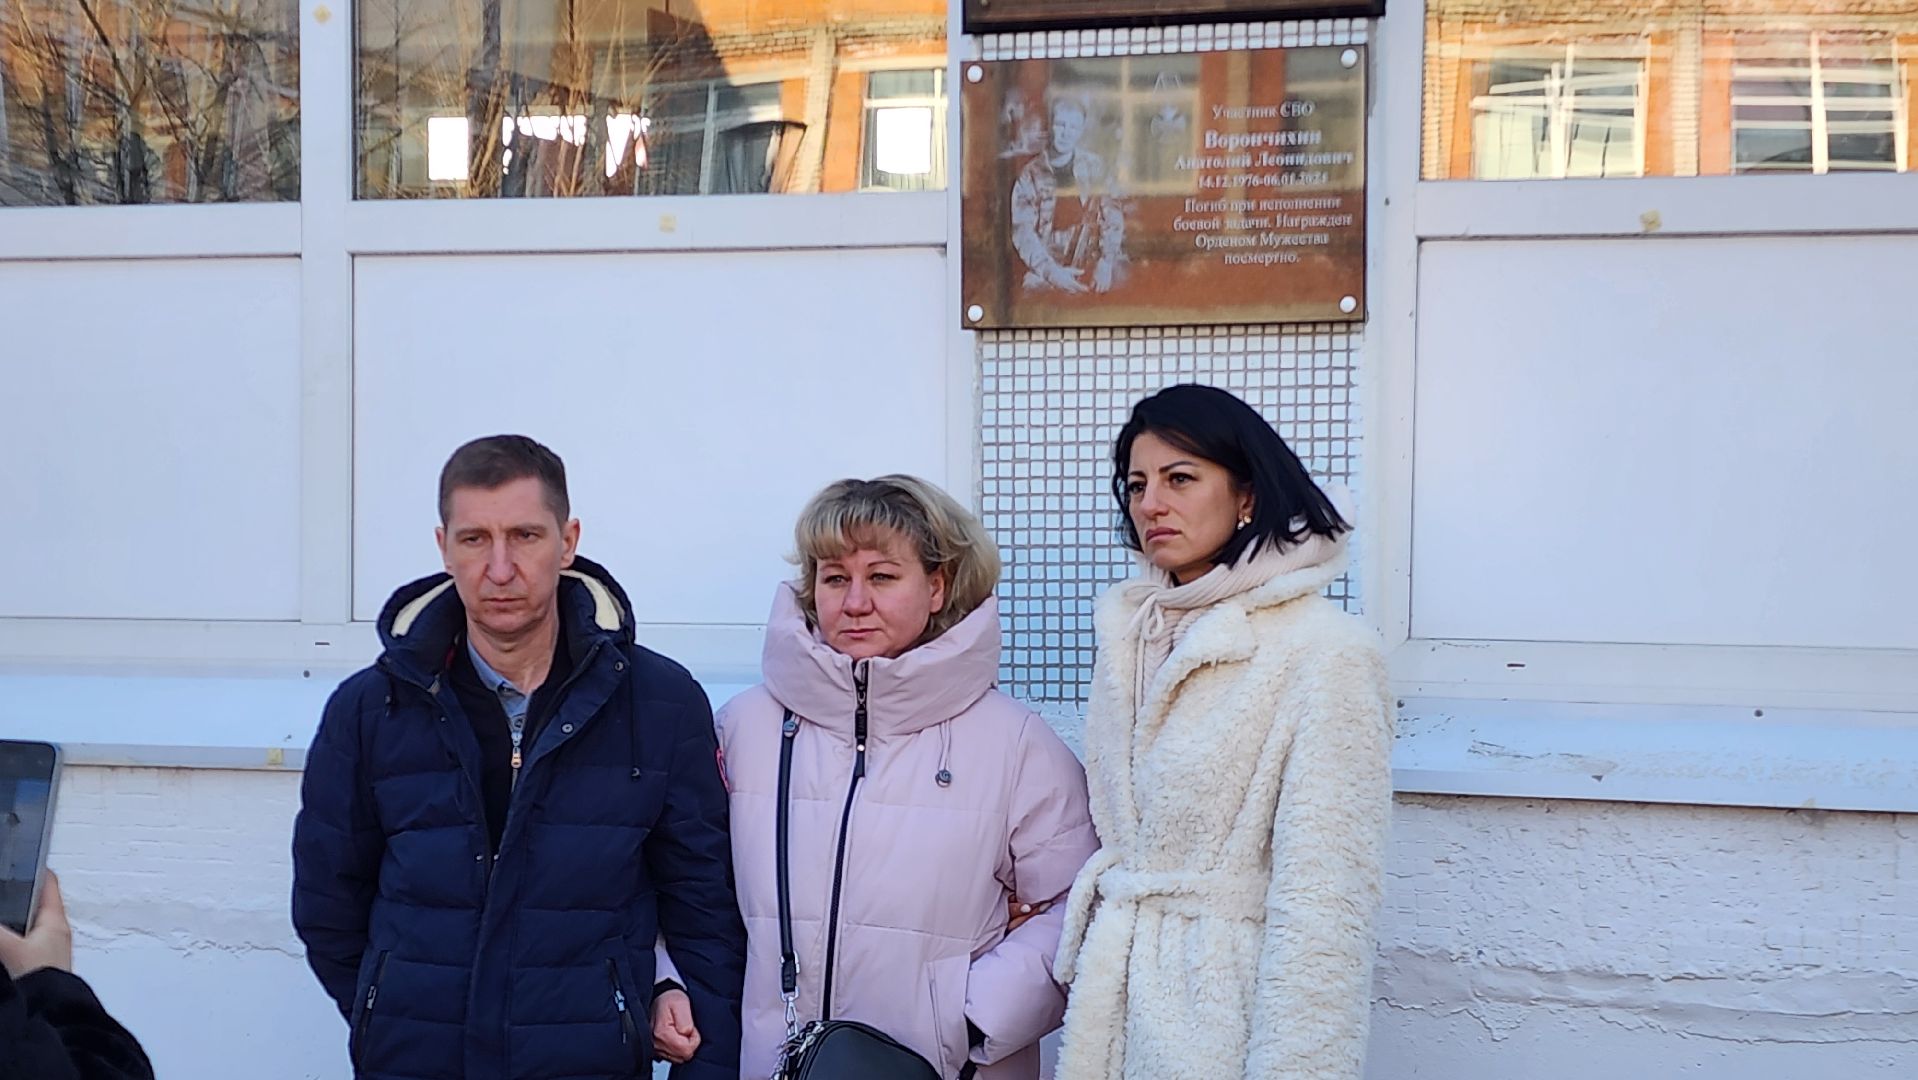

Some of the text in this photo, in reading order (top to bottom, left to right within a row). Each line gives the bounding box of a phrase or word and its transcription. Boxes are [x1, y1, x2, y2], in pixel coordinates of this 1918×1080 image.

[1212, 102, 1314, 120] Участник СВО
[1204, 129, 1322, 151] Ворончихин
[1175, 151, 1354, 170] Анатолий Леонидович
[1185, 197, 1341, 213] Погиб при исполнении
[1173, 215, 1220, 232] боевой
[1276, 213, 1353, 230] Награжден
[1195, 232, 1330, 250] Орденом Мужества
[1224, 251, 1300, 266] посмертно.
